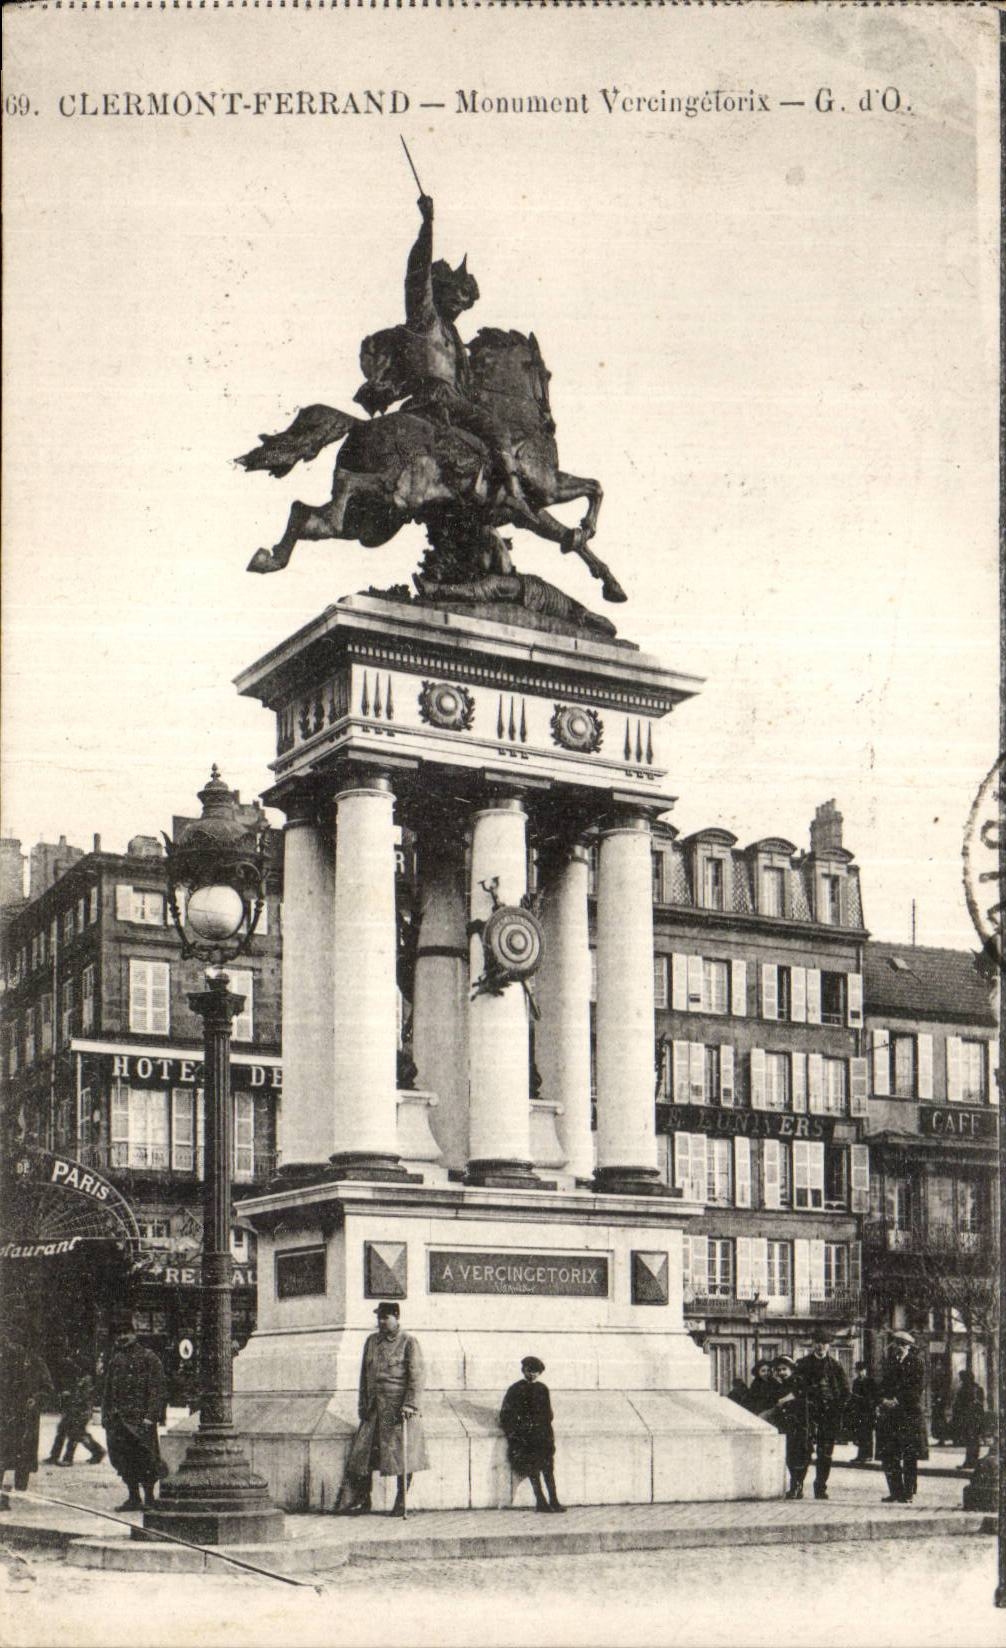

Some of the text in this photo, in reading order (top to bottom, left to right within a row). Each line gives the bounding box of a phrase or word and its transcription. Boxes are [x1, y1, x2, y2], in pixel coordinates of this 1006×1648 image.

[112, 1055, 205, 1083] HOTE
[51, 1160, 110, 1200] PARIS
[441, 1264, 599, 1284] A VERCINGETORIX
